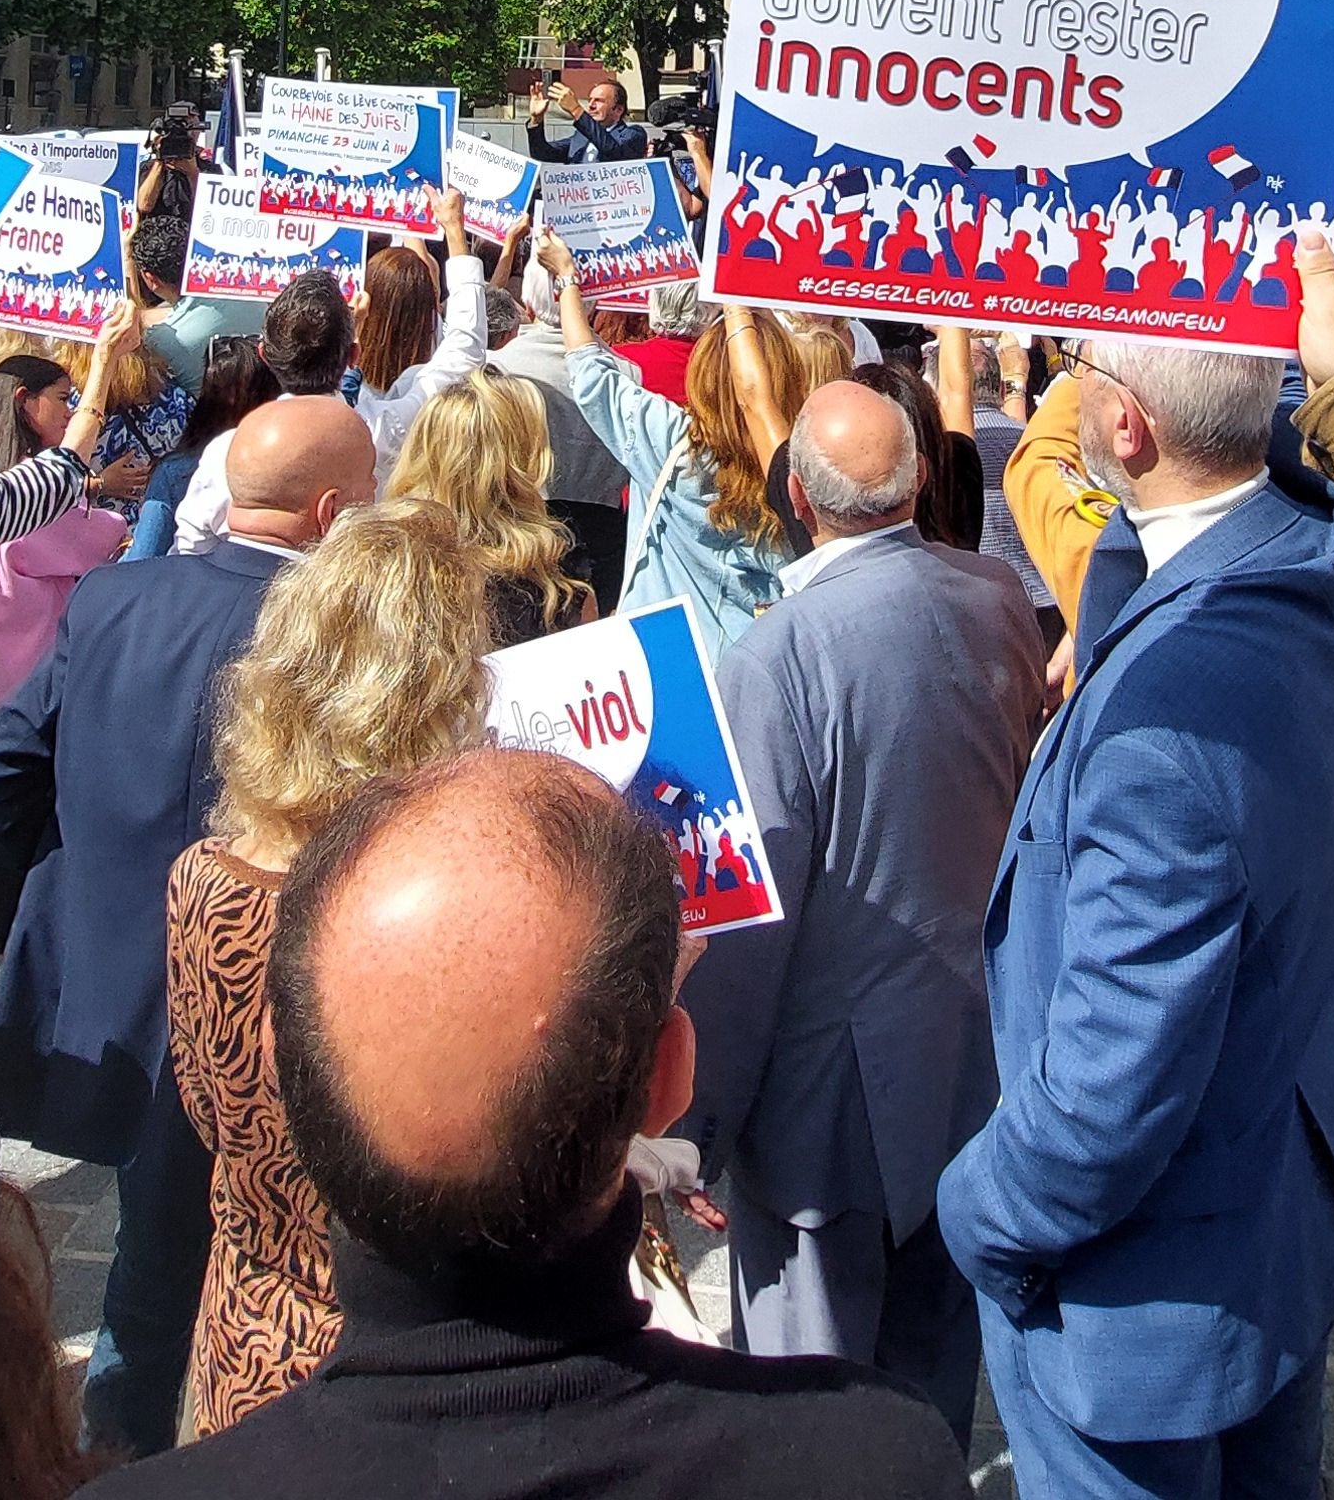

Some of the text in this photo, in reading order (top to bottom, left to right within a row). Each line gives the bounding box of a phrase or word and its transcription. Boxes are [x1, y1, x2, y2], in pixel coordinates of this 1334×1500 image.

[755, 19, 1125, 130] innocents
[271, 102, 286, 116] LA
[291, 101, 334, 124] HAINE
[338, 111, 360, 125] DES
[336, 92, 351, 105] SE
[352, 90, 379, 109] LÈVE
[379, 97, 416, 116] CONTRE
[30, 142, 39, 156] à
[42, 142, 118, 161] l'importation
[267, 128, 330, 146] DIMANCHE
[332, 135, 350, 148] 23
[352, 136, 379, 152] JUIN
[380, 138, 391, 153] À
[587, 169, 599, 182] SE
[598, 165, 619, 181] LÈVE
[619, 163, 648, 178] CONTRE
[42, 185, 102, 226] Hamas
[546, 191, 556, 203] LA
[557, 185, 590, 206] HAINE
[593, 186, 610, 200] DES
[596, 210, 609, 222] 23
[610, 207, 630, 221] JUIN
[221, 217, 270, 239] mon
[276, 217, 317, 247] feuj
[798, 277, 1226, 334] #CESSEZLEVIOL #TOUCHEPASAMONFEUJ
[681, 909, 707, 924] EUJ
